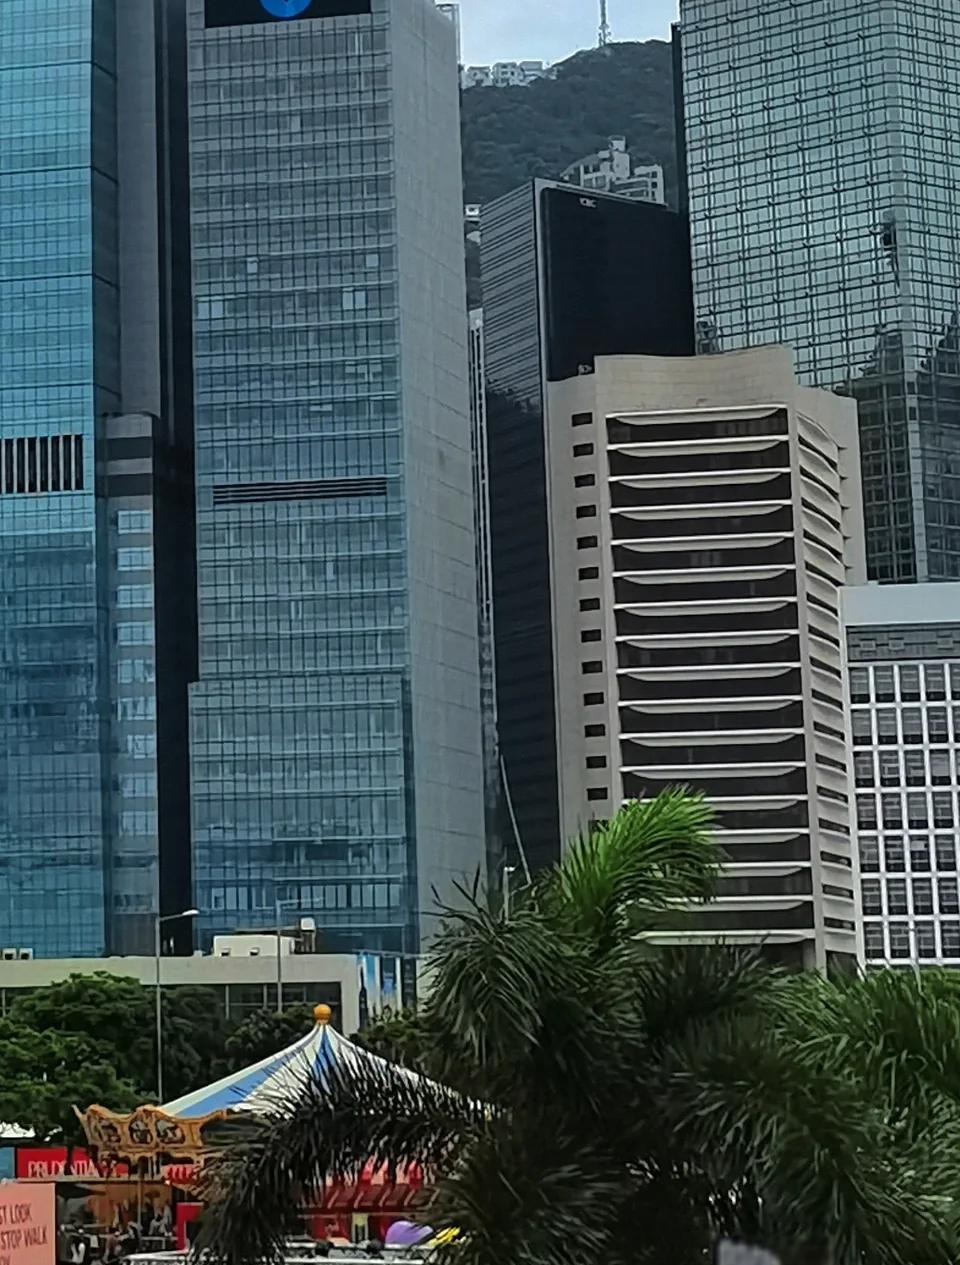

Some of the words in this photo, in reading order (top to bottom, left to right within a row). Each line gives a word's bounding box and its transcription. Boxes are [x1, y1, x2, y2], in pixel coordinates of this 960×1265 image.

[28, 1159, 100, 1177] PRUDNTIA
[10, 1202, 32, 1224] LOOK
[1, 1229, 21, 1250] STOP
[23, 1224, 48, 1247] WALK
